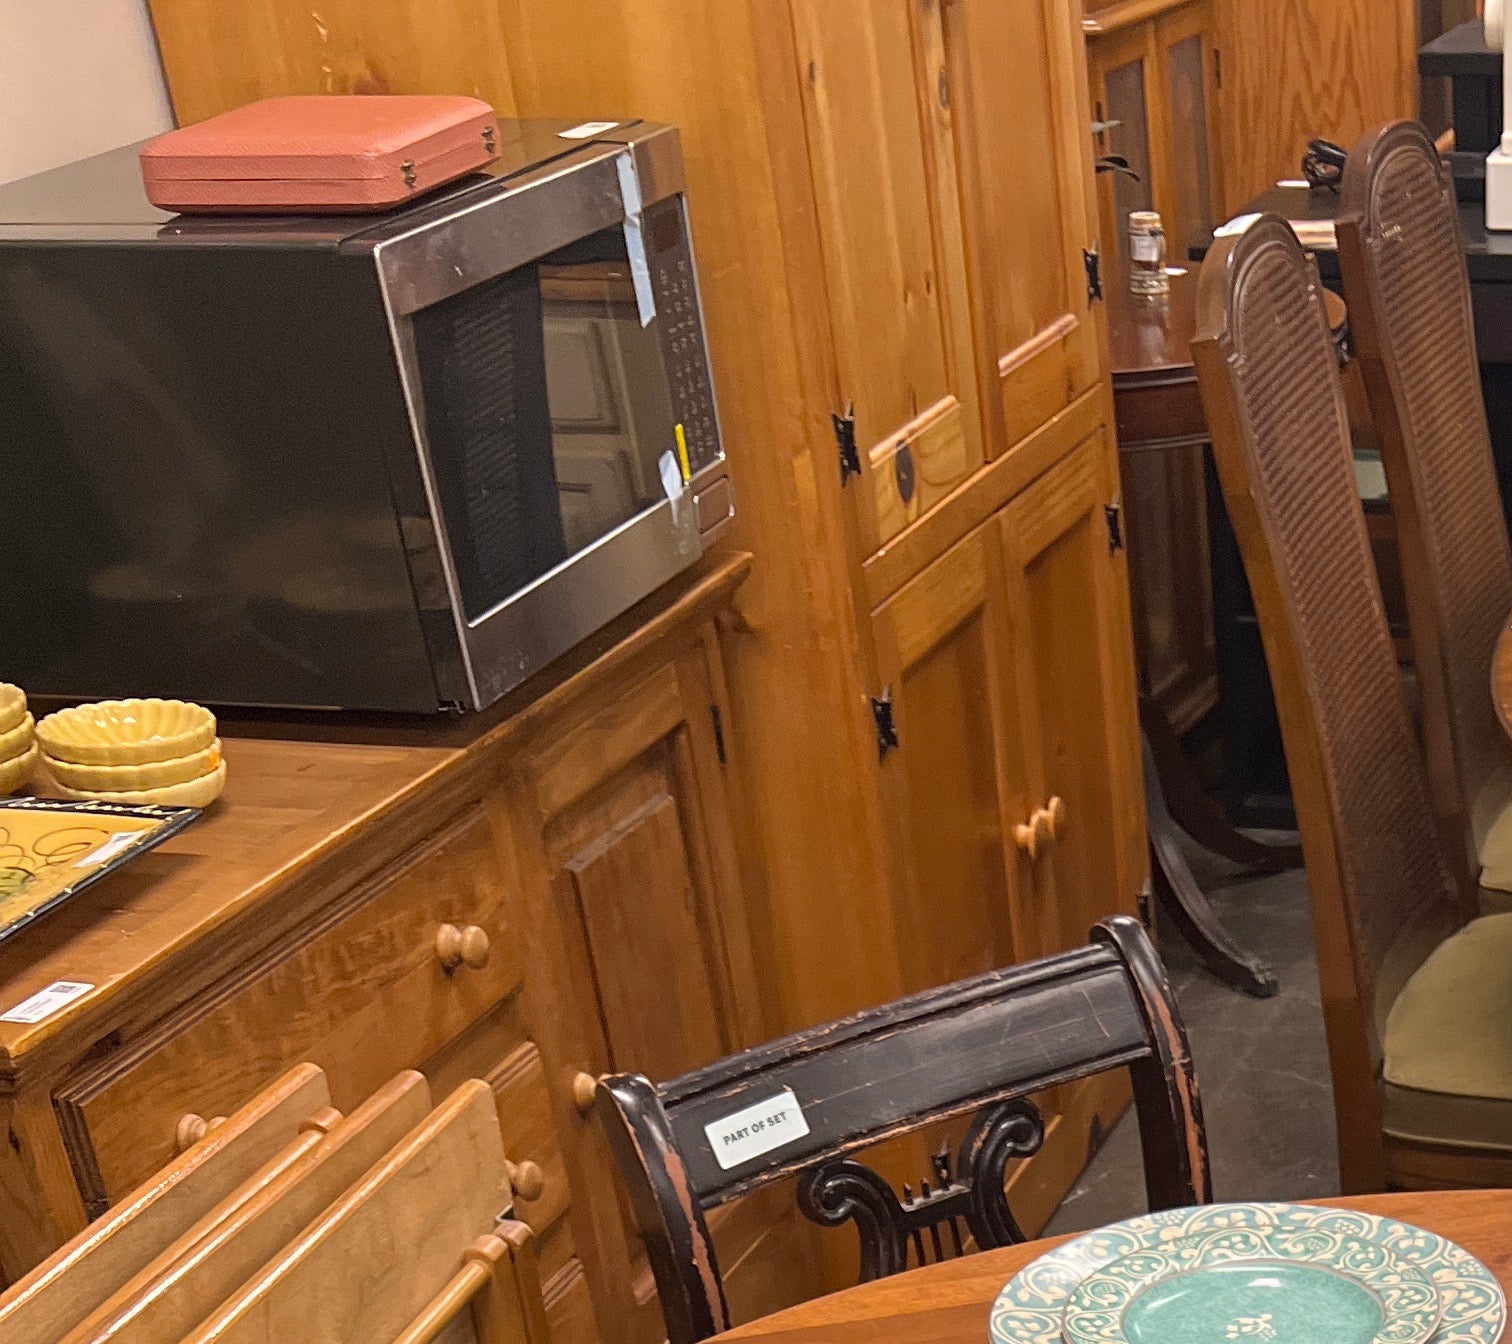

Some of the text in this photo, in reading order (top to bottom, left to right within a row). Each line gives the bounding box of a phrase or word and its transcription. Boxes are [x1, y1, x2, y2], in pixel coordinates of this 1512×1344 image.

[722, 1111, 787, 1146] PART OF SET
